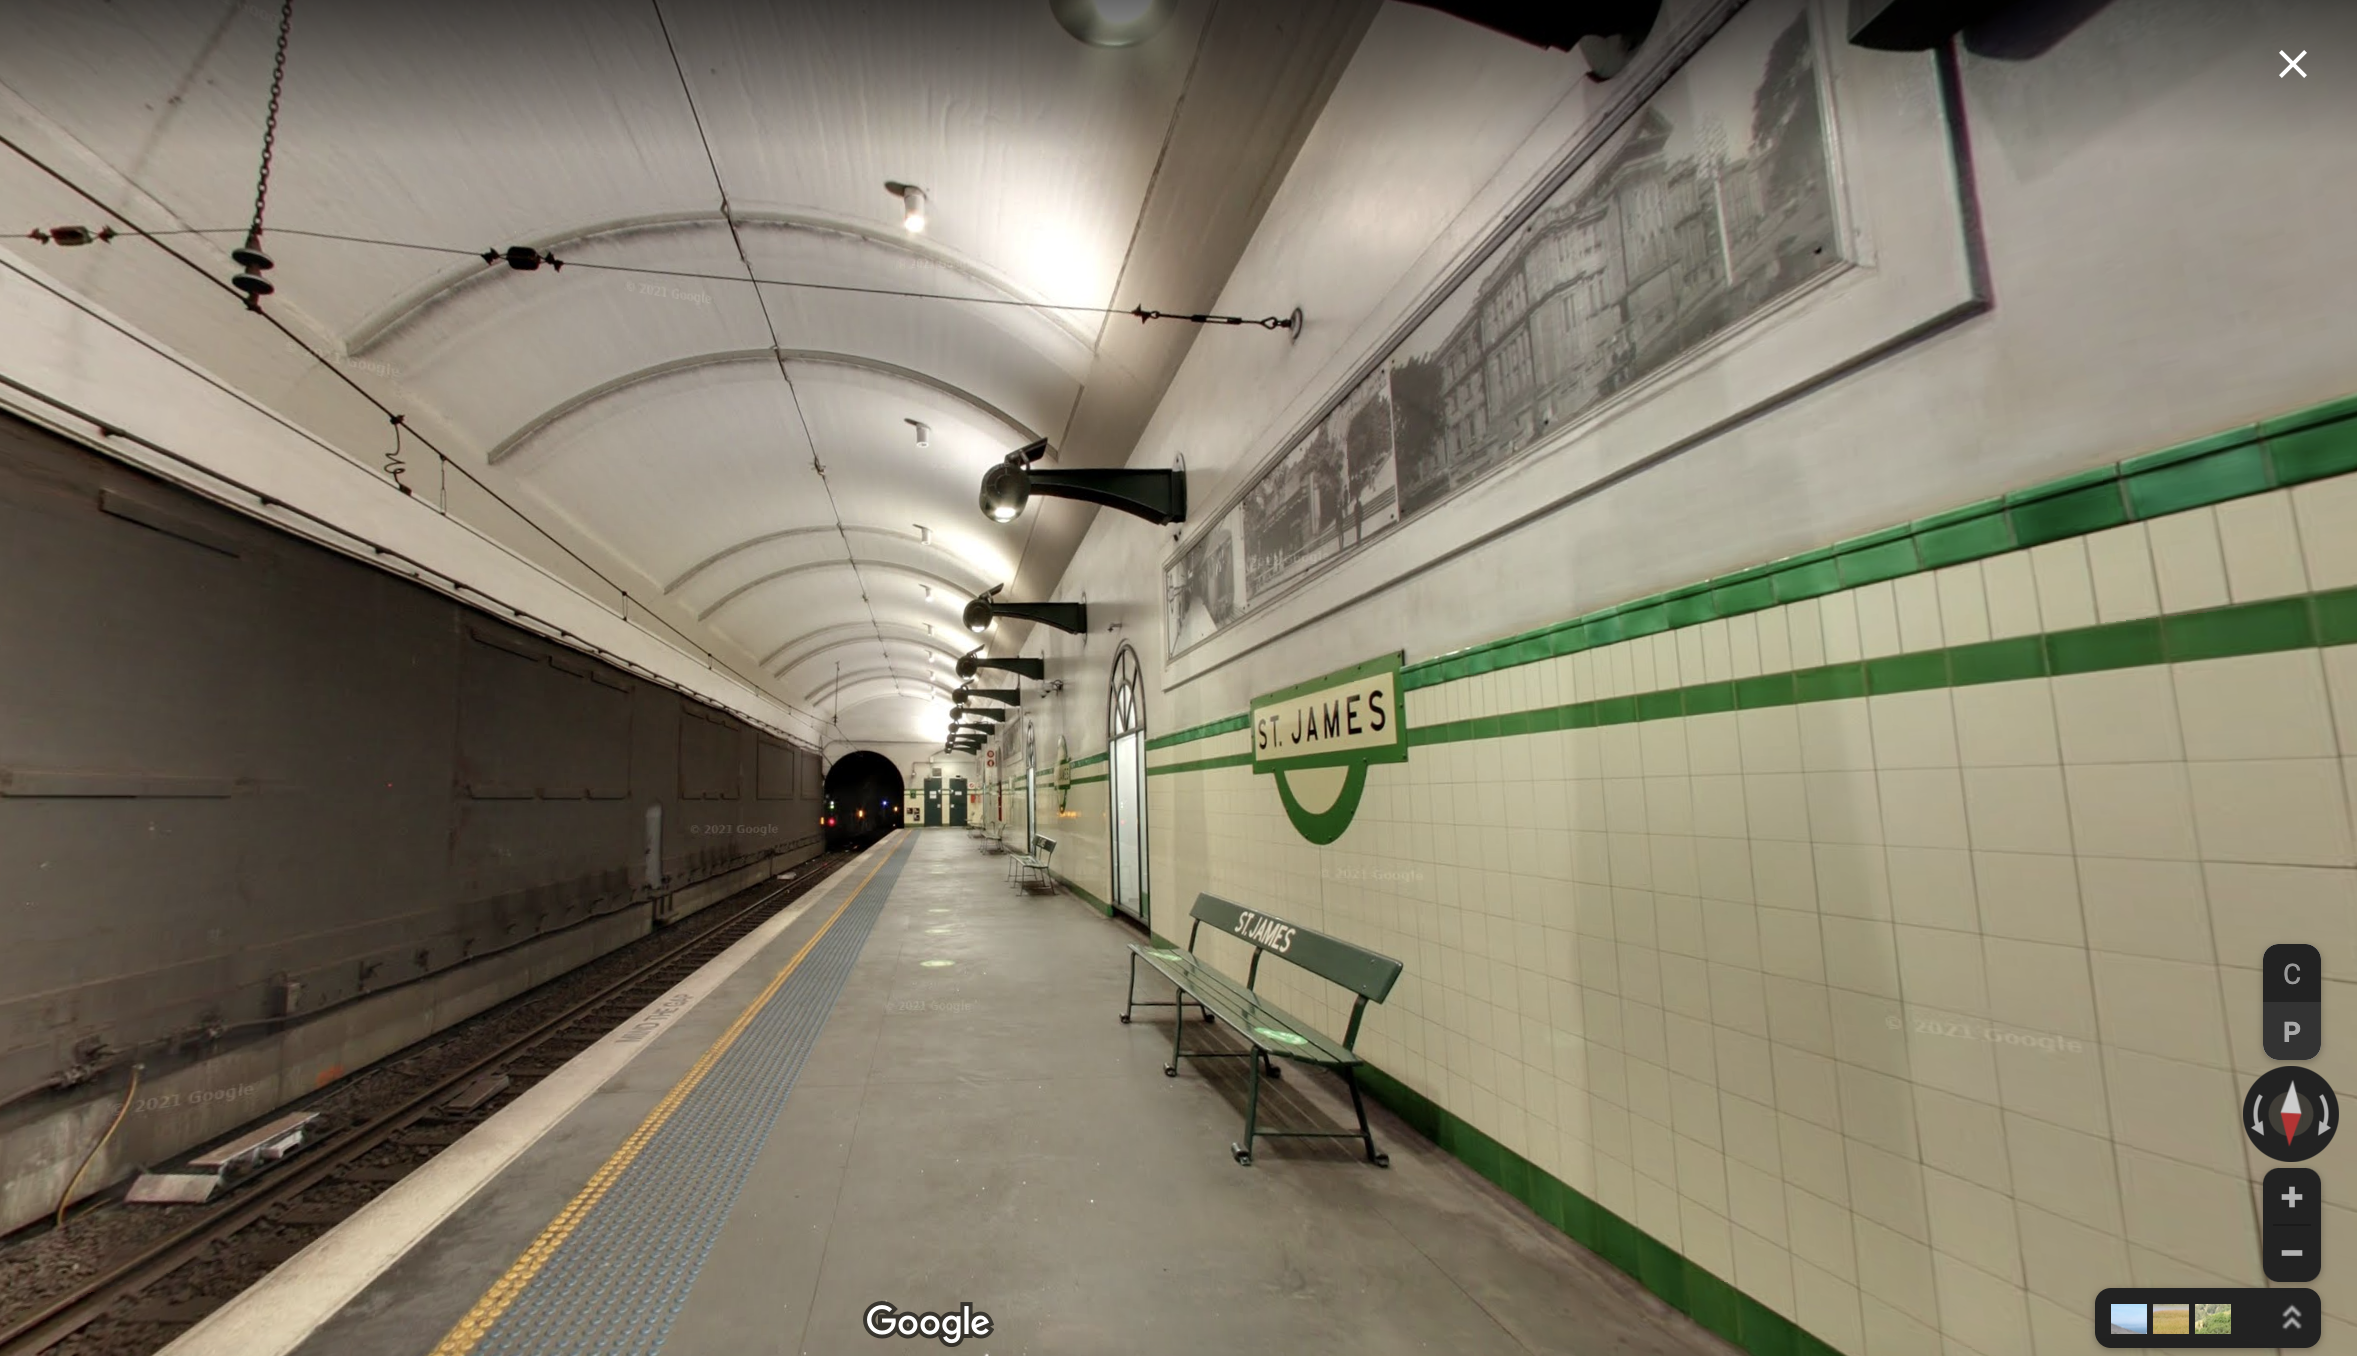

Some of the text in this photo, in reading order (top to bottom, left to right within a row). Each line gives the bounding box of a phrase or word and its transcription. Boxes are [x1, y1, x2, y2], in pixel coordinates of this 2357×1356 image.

[1258, 689, 1386, 750] ST. JAMES
[1234, 911, 1296, 953] ST. JAMES
